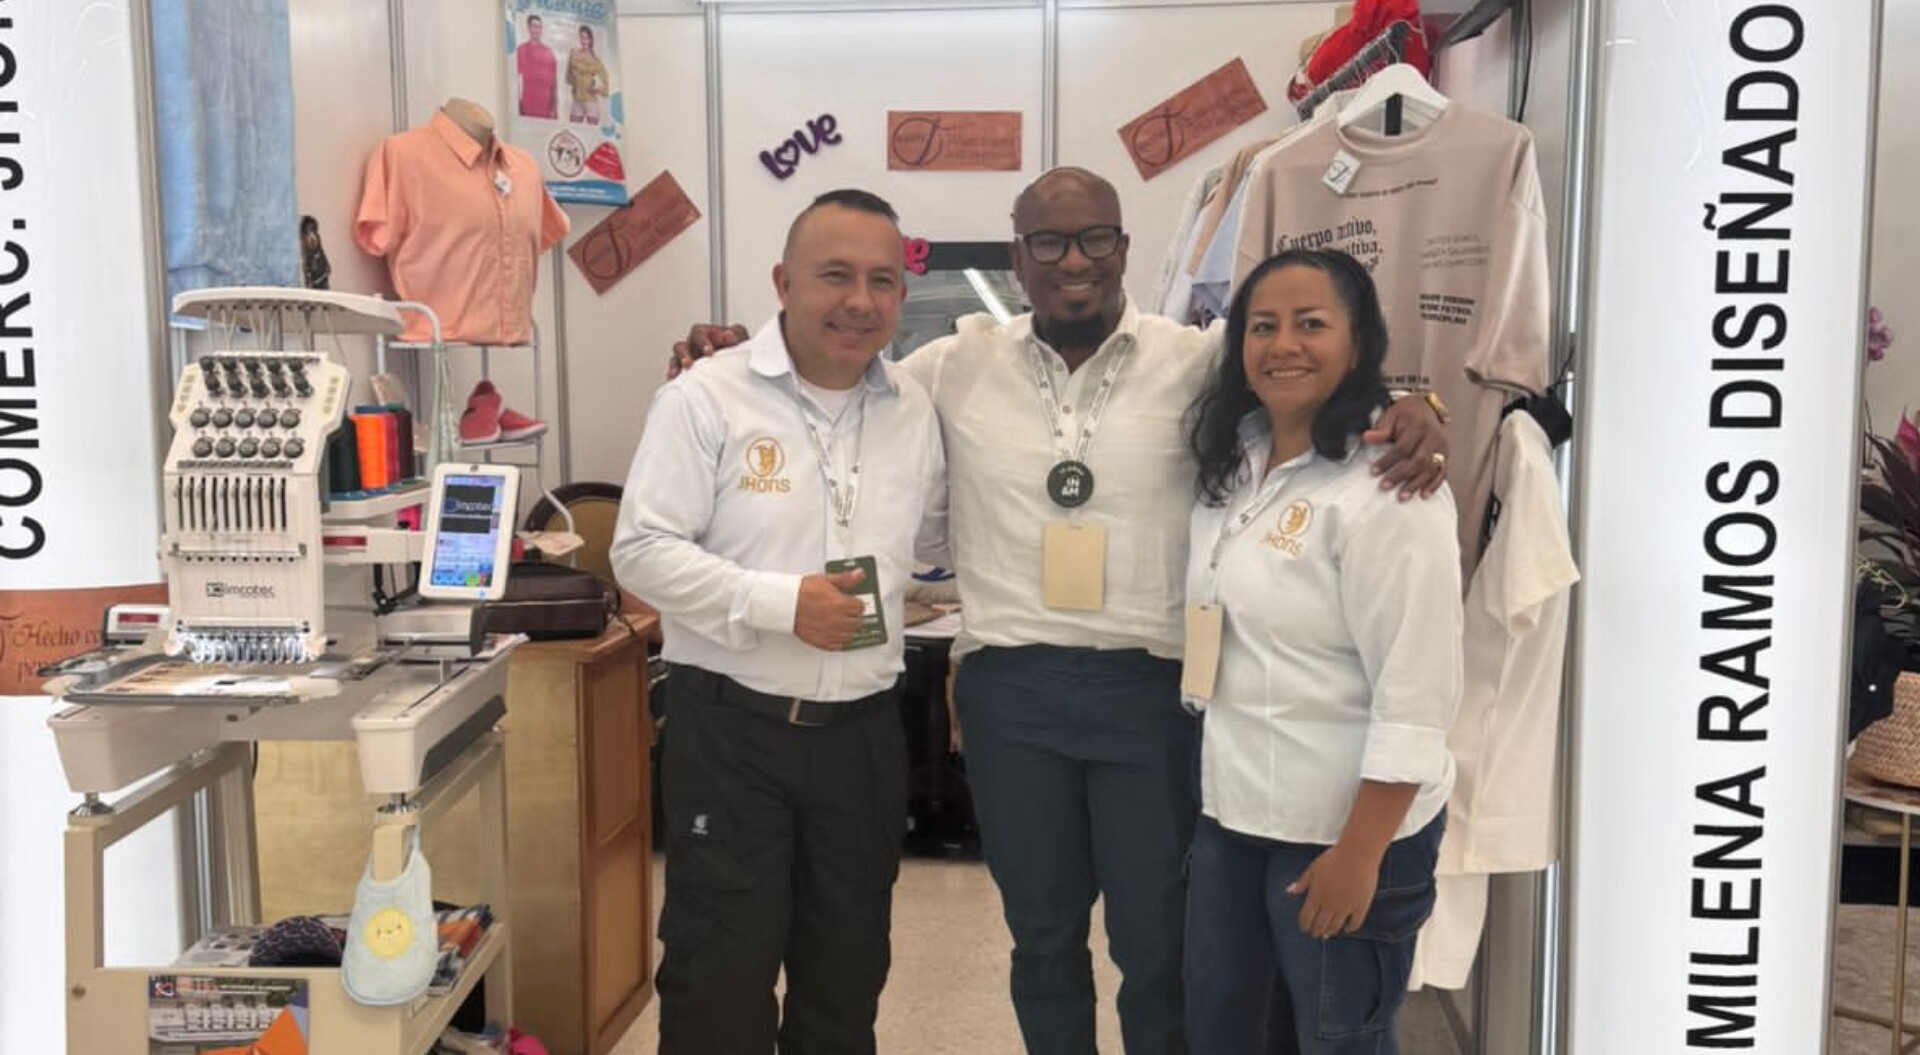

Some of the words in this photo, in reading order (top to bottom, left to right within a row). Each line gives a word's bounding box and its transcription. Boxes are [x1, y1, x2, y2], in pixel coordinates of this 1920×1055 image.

[1704, 4, 1804, 431] DISEÑADO
[1698, 459, 1780, 743] RAMOS
[1687, 766, 1767, 1049] MILENA
